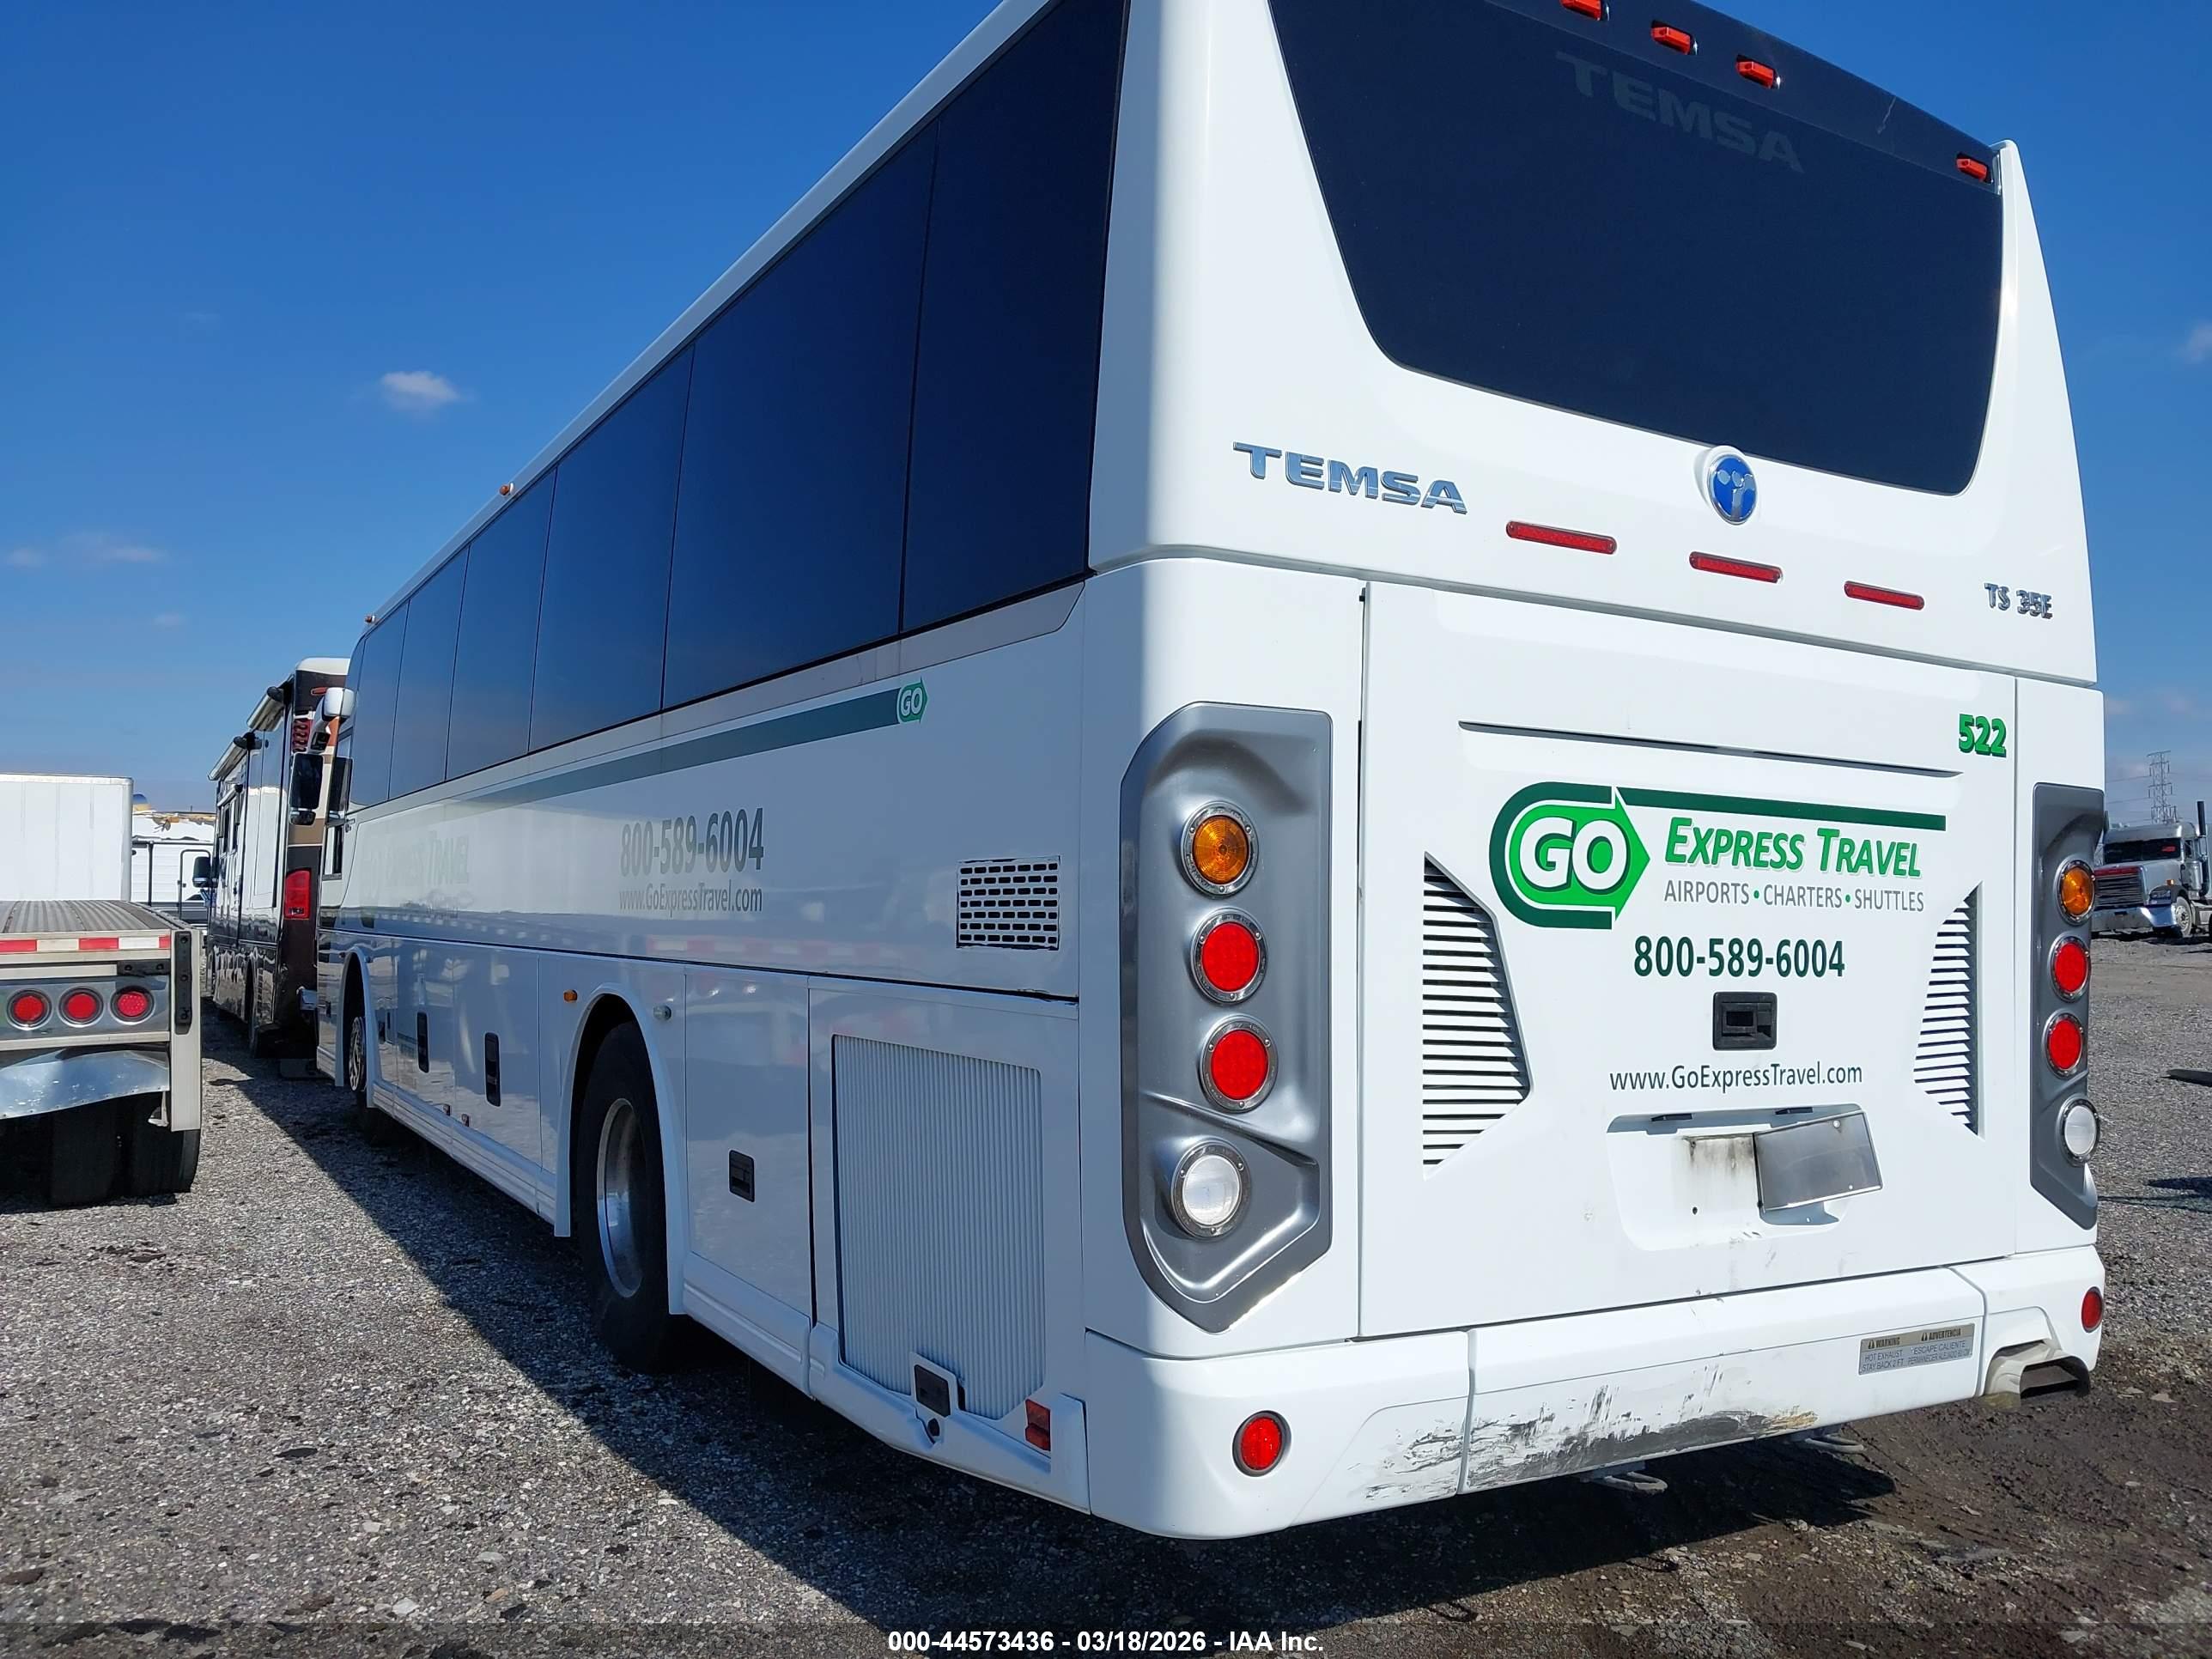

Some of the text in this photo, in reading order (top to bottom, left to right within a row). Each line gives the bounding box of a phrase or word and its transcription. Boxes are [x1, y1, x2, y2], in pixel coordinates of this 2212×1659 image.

[1555, 51, 1804, 173] TEMSA
[1234, 442, 1467, 514] TEMSA
[1984, 582, 2011, 611] TS
[901, 687, 923, 716] GO
[1958, 713, 2008, 758] 522
[621, 807, 764, 878] 800-589-6004
[1518, 815, 1630, 892] GO
[1664, 816, 1923, 878] EXPRESS TRAVEL
[619, 878, 763, 919] www.GoExpressTravel.com
[1633, 936, 1845, 978] 800-589-6004
[1610, 1061, 1863, 1093] www.GoExpressTravel.com
